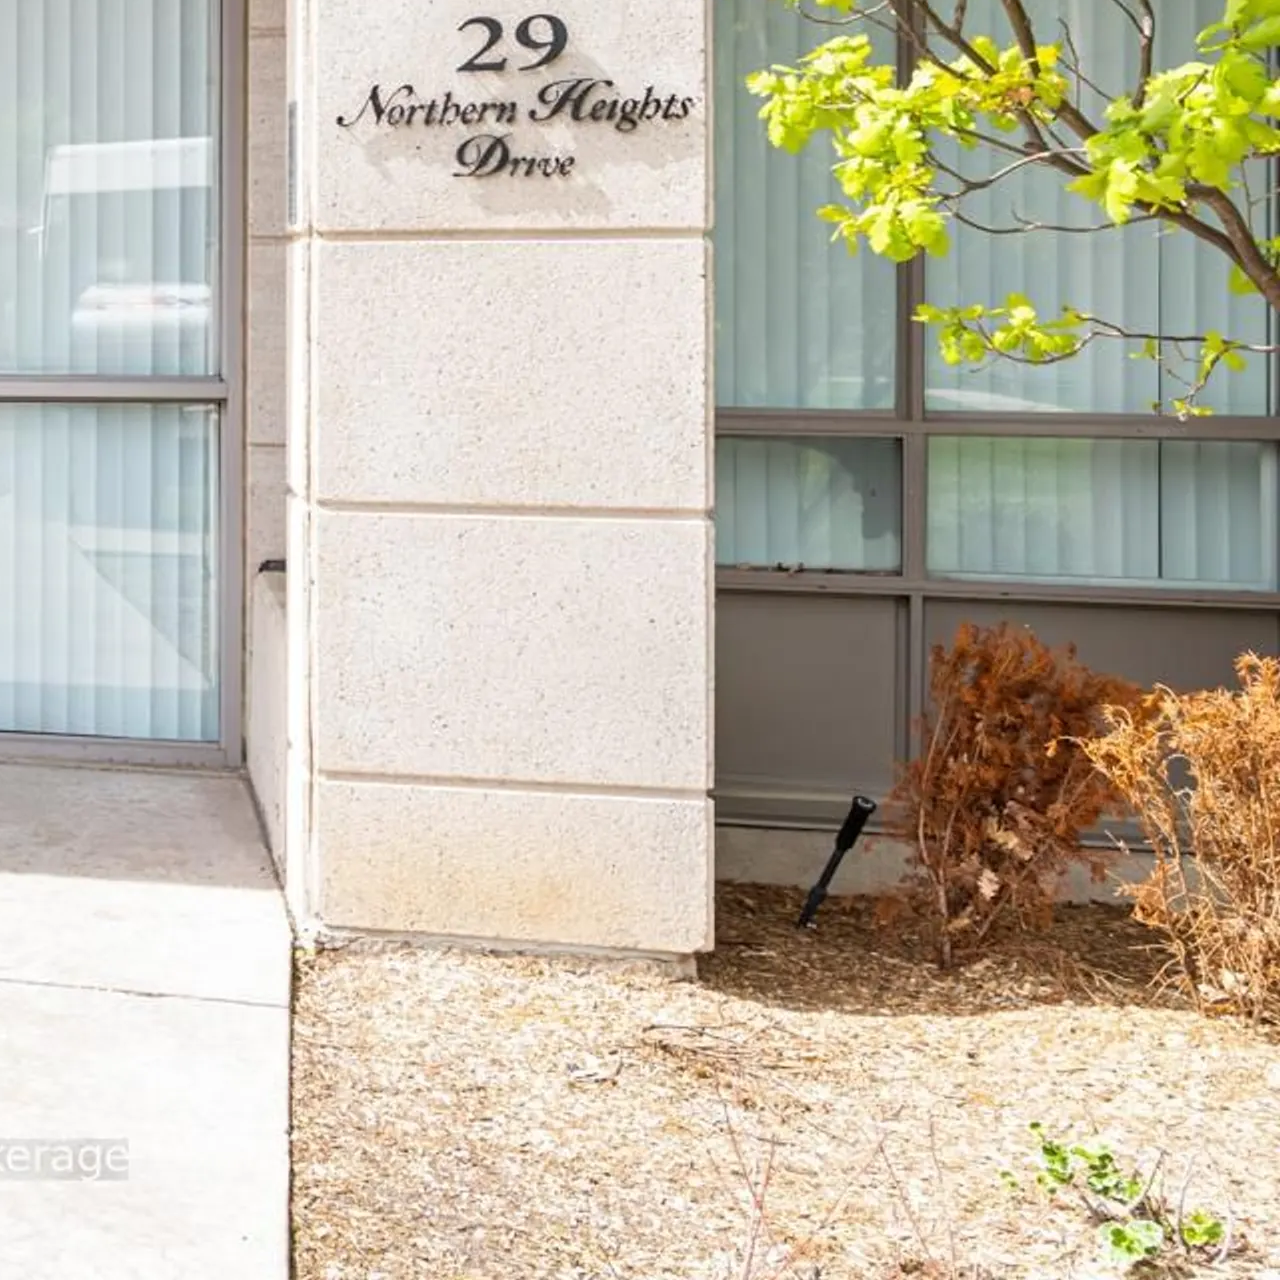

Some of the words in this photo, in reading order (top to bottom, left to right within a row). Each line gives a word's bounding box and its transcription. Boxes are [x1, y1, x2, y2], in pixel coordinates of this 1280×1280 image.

[456, 13, 569, 72] 29
[336, 83, 518, 128] Northern
[528, 77, 694, 133] Heights
[452, 132, 576, 179] Drive
